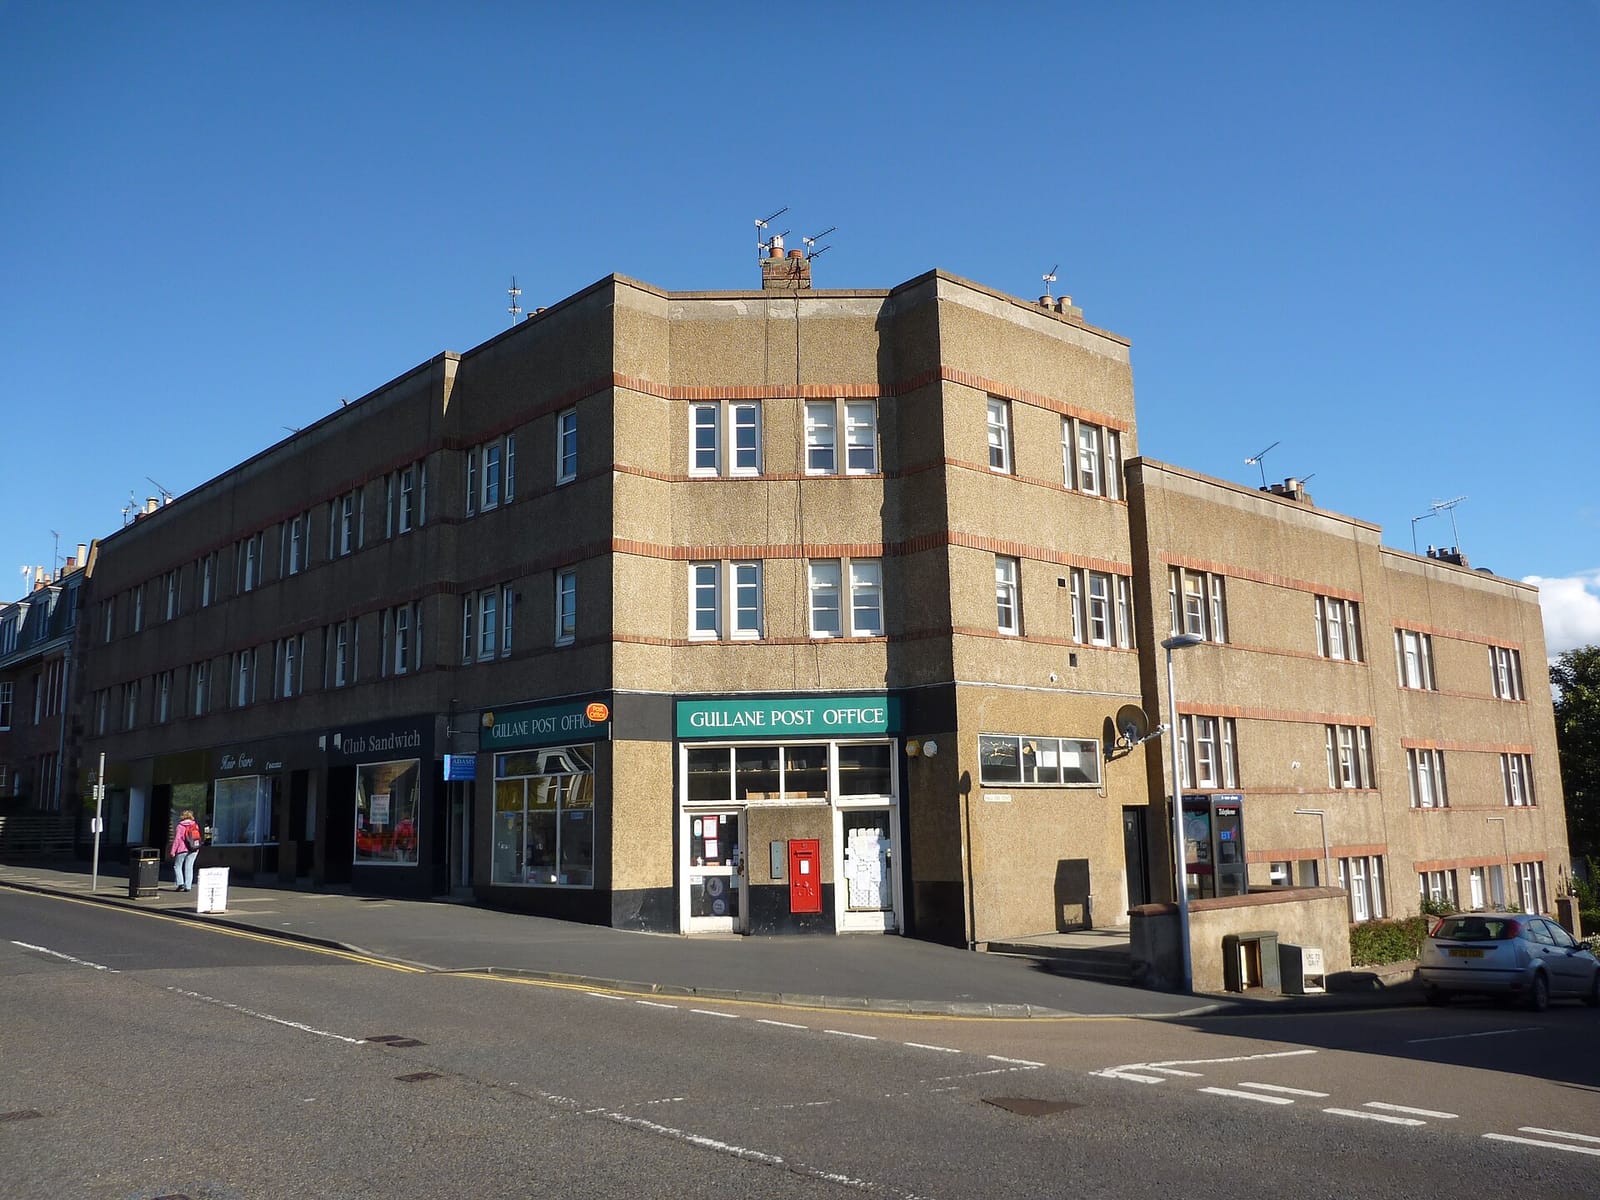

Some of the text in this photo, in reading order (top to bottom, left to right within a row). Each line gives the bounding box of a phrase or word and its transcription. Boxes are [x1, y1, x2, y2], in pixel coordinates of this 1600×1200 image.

[492, 721, 528, 738] GULLANE
[532, 717, 557, 734] POST
[690, 708, 885, 726] GULLANE POST OFFICE
[343, 729, 421, 755] Club Sandwich
